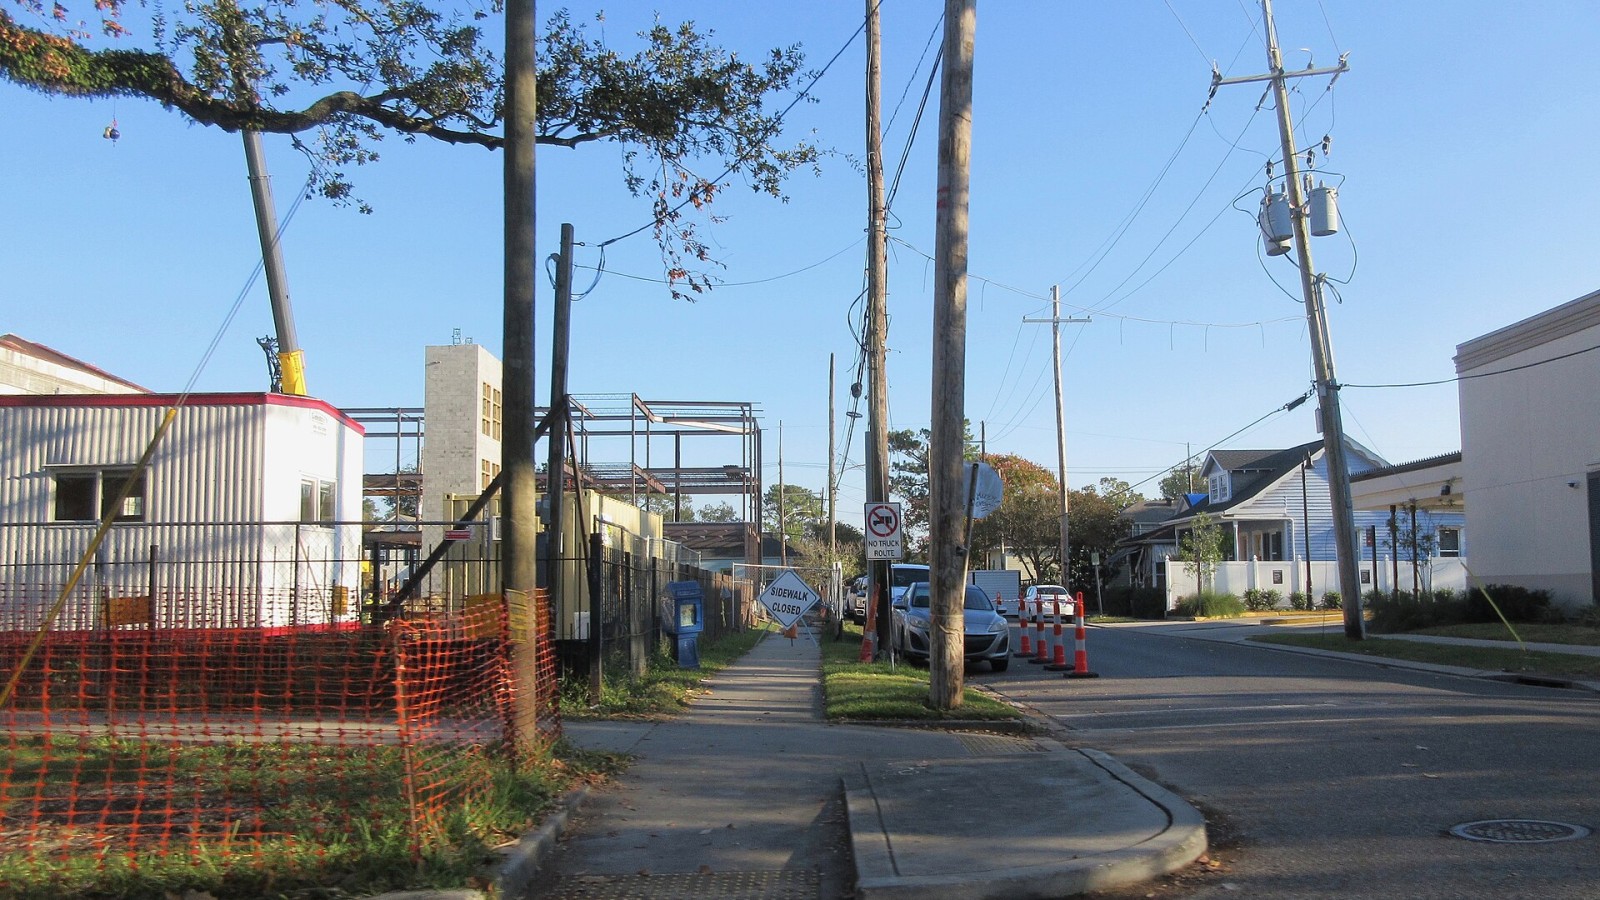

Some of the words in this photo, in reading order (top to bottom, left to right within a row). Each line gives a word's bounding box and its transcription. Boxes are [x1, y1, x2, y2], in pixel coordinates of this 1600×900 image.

[868, 540, 878, 548] NO
[770, 586, 809, 602] SIDEWALK
[772, 602, 801, 615] CLOSED
